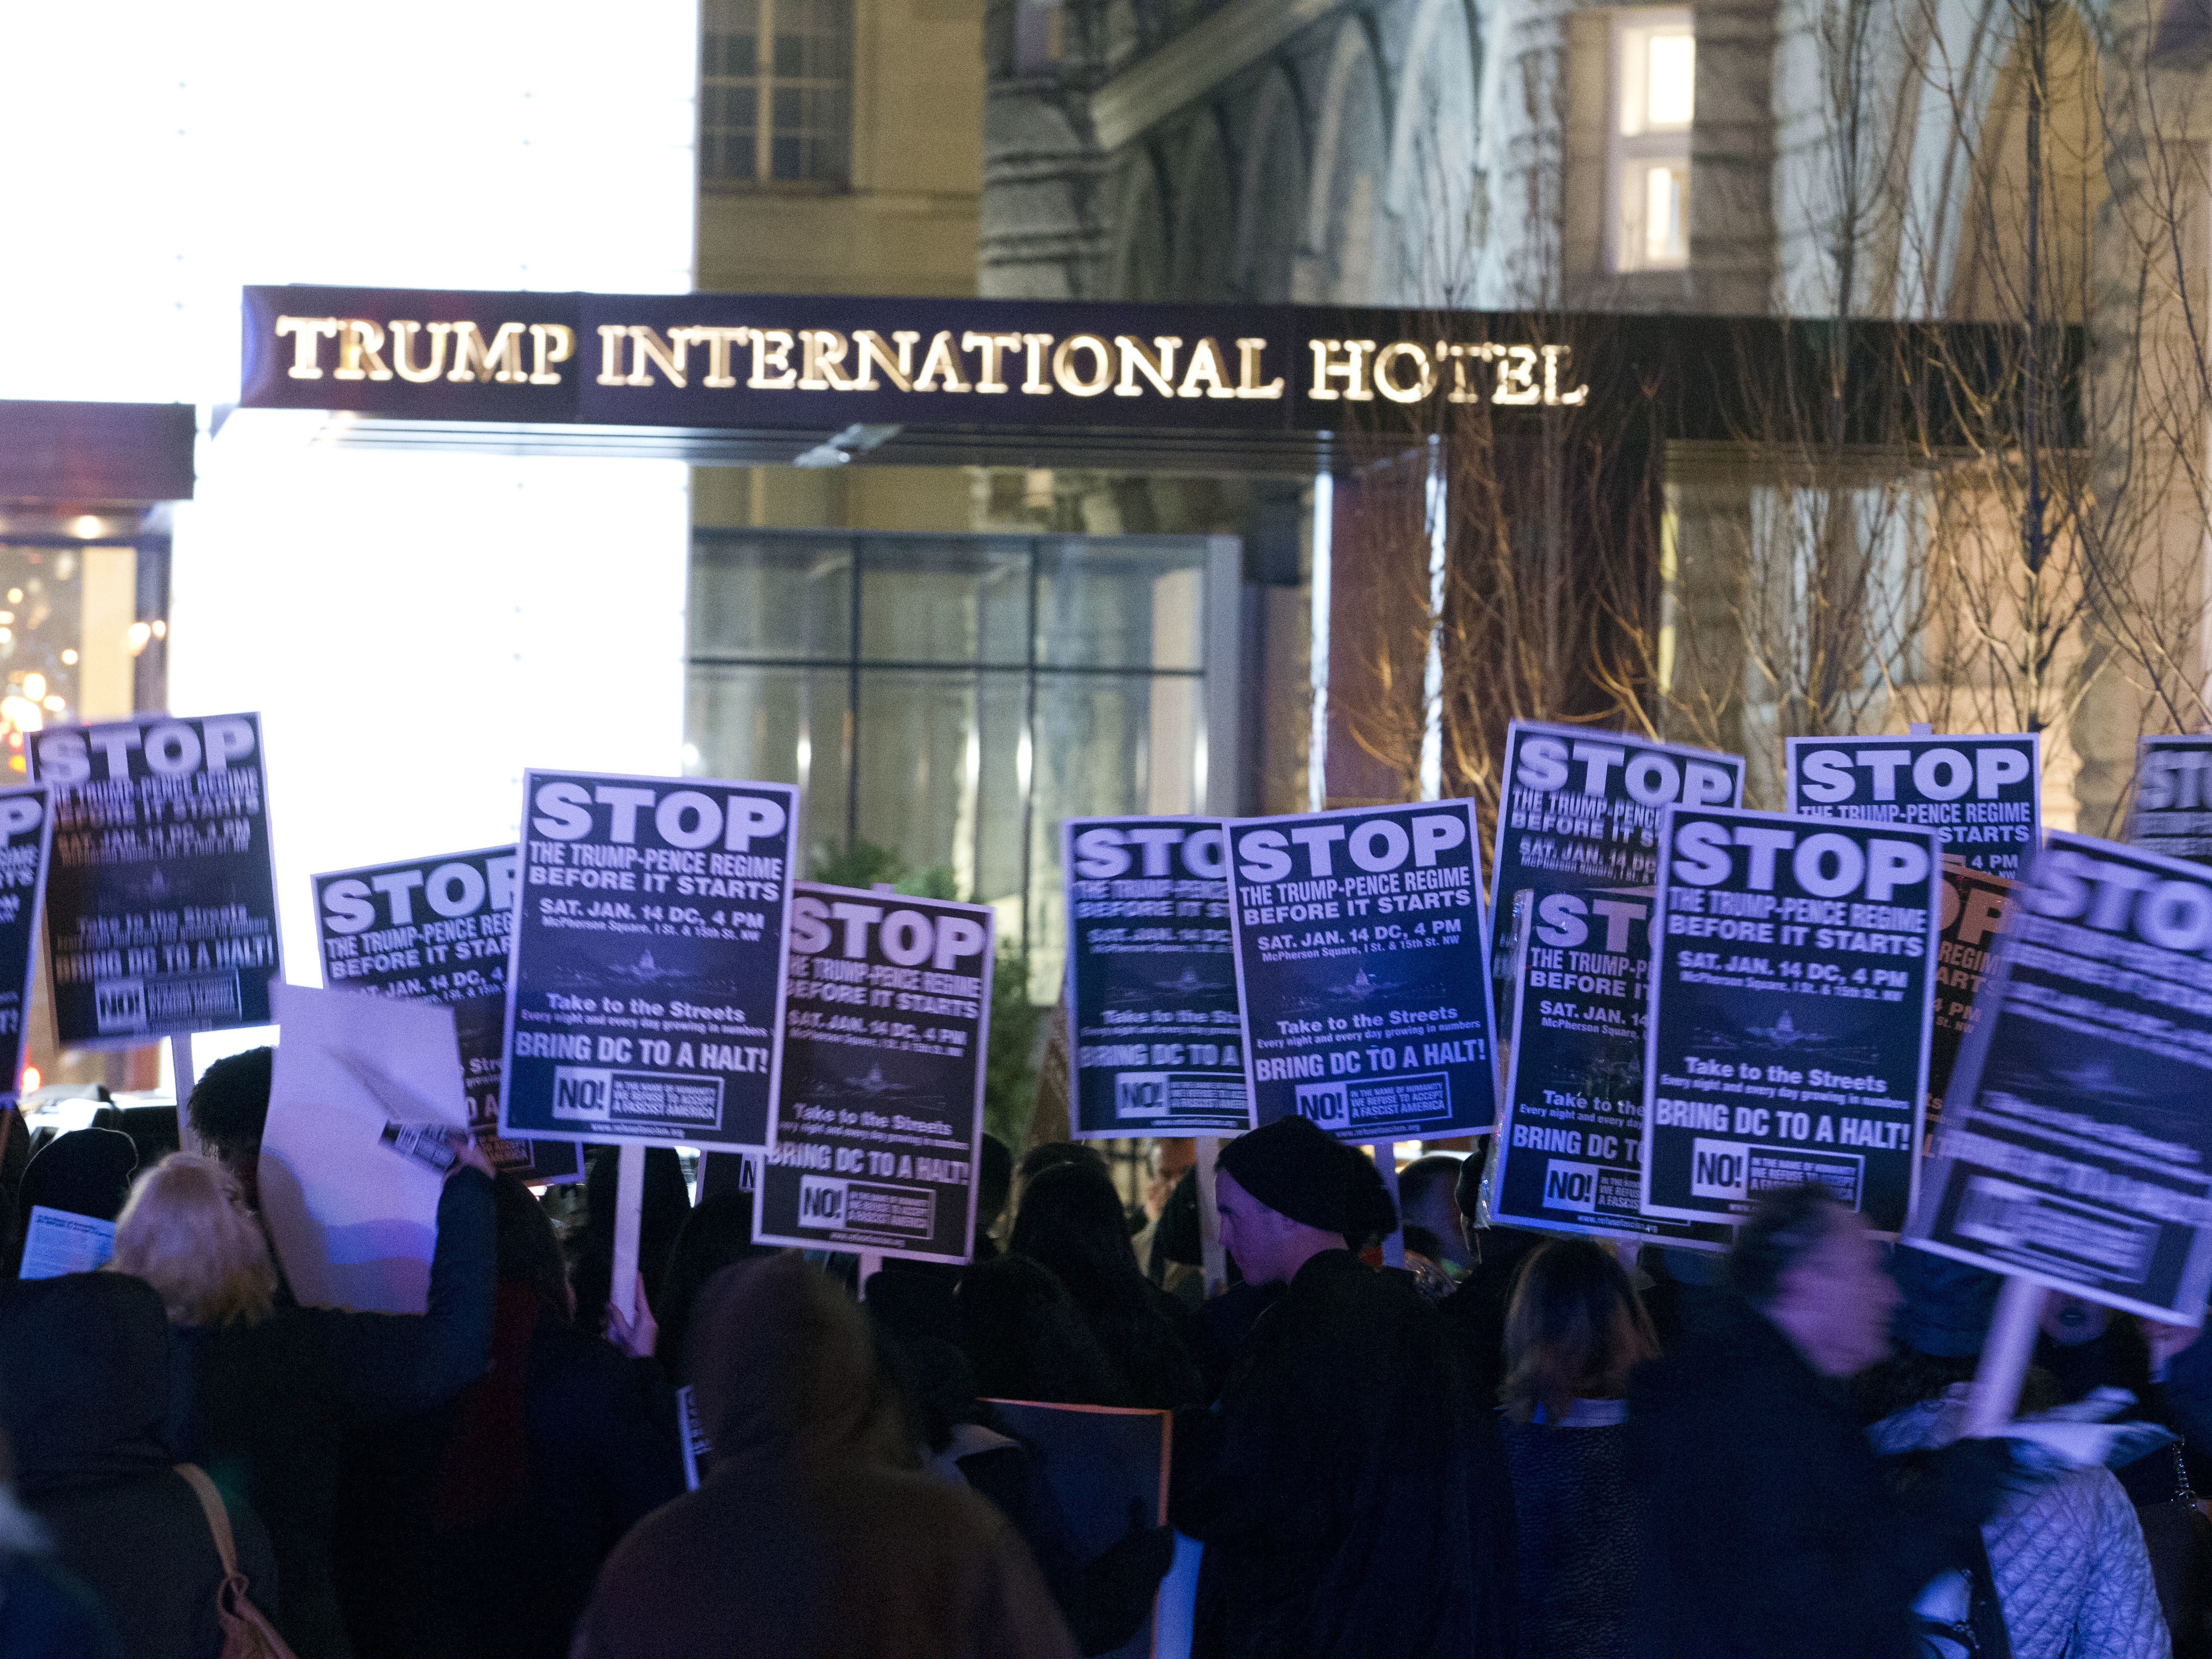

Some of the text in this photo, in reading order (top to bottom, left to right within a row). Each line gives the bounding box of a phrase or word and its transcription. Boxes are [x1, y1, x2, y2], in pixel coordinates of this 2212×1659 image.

[275, 315, 1589, 405] TRUMP INTERNATIONAL HOTEL
[39, 719, 254, 783] STOP
[1517, 734, 1732, 809] STOP
[1801, 748, 2030, 803] STOP
[532, 781, 787, 853] STOP
[1511, 810, 1605, 839] BEFORE
[1966, 802, 2030, 823] REGIME
[1238, 815, 1466, 883] STOP
[1939, 825, 2030, 843] STARTS
[530, 841, 783, 882] THE TRUMP-PENCE REGIME
[1075, 828, 1227, 879] STO
[1672, 821, 1930, 902] STOP
[1971, 854, 2019, 868] 4 PM
[322, 856, 517, 935] STOP
[529, 866, 781, 903] BEFORE IT STARTS
[1239, 885, 1272, 907] THE
[1276, 874, 1401, 903] TRUMP-PENCE
[1405, 866, 1471, 893] REGIME
[1669, 886, 1706, 913] THE
[2018, 849, 2212, 950] STO
[539, 897, 765, 930] SAT. JAN. 14 DC, 4 PM
[1243, 901, 1340, 926] BEFORE
[1347, 899, 1370, 917] IT
[1378, 889, 1471, 914] STARTS
[1536, 892, 1653, 953] ST
[325, 911, 513, 960] THE TRUMP-PENCE REG
[790, 896, 986, 971] STOP
[1257, 918, 1462, 951] SAT. JAN. 14 DC, 4 PM
[1262, 948, 1320, 963] McPherson
[1322, 945, 1361, 959] Square,
[1370, 941, 1386, 952] St.
[1388, 941, 1397, 951] &
[1401, 938, 1423, 950] 15th
[1425, 936, 1440, 947] St.
[1442, 935, 1460, 945] NW
[1668, 914, 1925, 958] BEFORE IT STARTS
[328, 944, 450, 980] BEFORE IT
[1531, 947, 1564, 970] THE
[1530, 970, 1627, 998] BEFORE
[1851, 967, 1867, 984] 4
[1872, 969, 1909, 988] PM
[546, 992, 746, 1023] Take to the Streets
[1276, 1006, 1458, 1036] Take to the Streets
[1540, 1000, 1626, 1025] SAT. JAN.
[515, 1031, 769, 1074] BRING DC TO A HALT!
[1257, 1019, 1481, 1050] Every night and every day growing in numbers
[1255, 1039, 1486, 1082] BRING DC TO A HALT!
[1684, 1056, 1887, 1093] Take to the Streets
[559, 1076, 606, 1110] NO!
[1301, 1092, 1345, 1121] NO!
[1542, 1089, 1645, 1117] Take to the
[1511, 1123, 1618, 1159] BRING DC
[1655, 1097, 1729, 1132] BRING
[1734, 1106, 1770, 1137] DC
[1776, 1111, 1811, 1141] TO
[1815, 1115, 1834, 1143] A
[1839, 1117, 1911, 1151] HALT!
[835, 1147, 913, 1179] DC TO A
[1697, 1150, 1743, 1188] NO!
[804, 1186, 843, 1218] NO!
[1548, 1171, 1593, 1202] NO!
